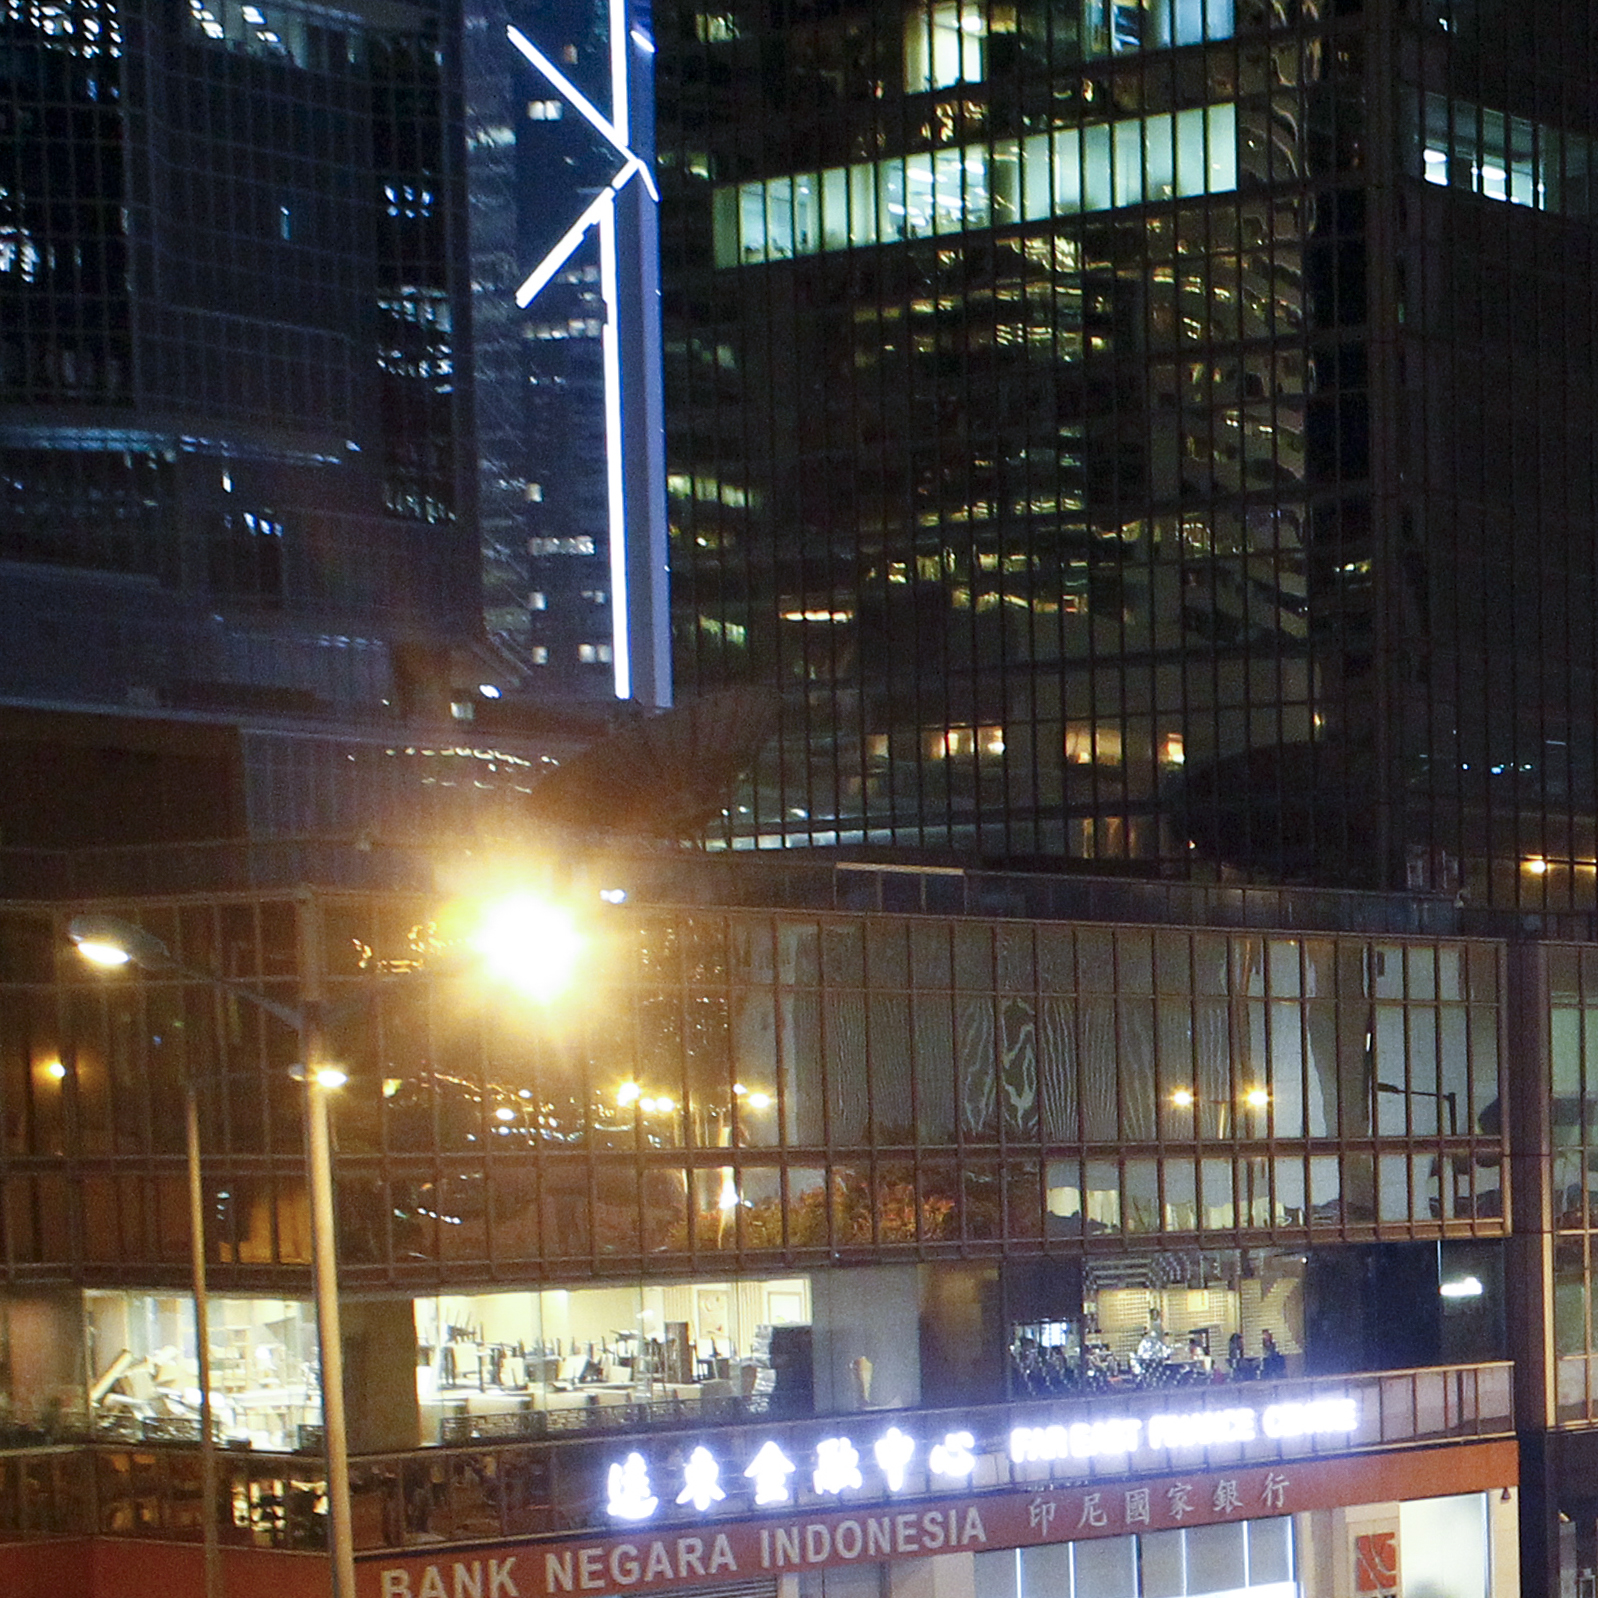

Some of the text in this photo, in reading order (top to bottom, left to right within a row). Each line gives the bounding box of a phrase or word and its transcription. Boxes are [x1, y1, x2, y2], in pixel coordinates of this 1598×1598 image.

[1028, 1471, 1291, 1538] 印尼國家銀行
[544, 1533, 738, 1595] NEGARA
[760, 1506, 988, 1569] INDONESIA
